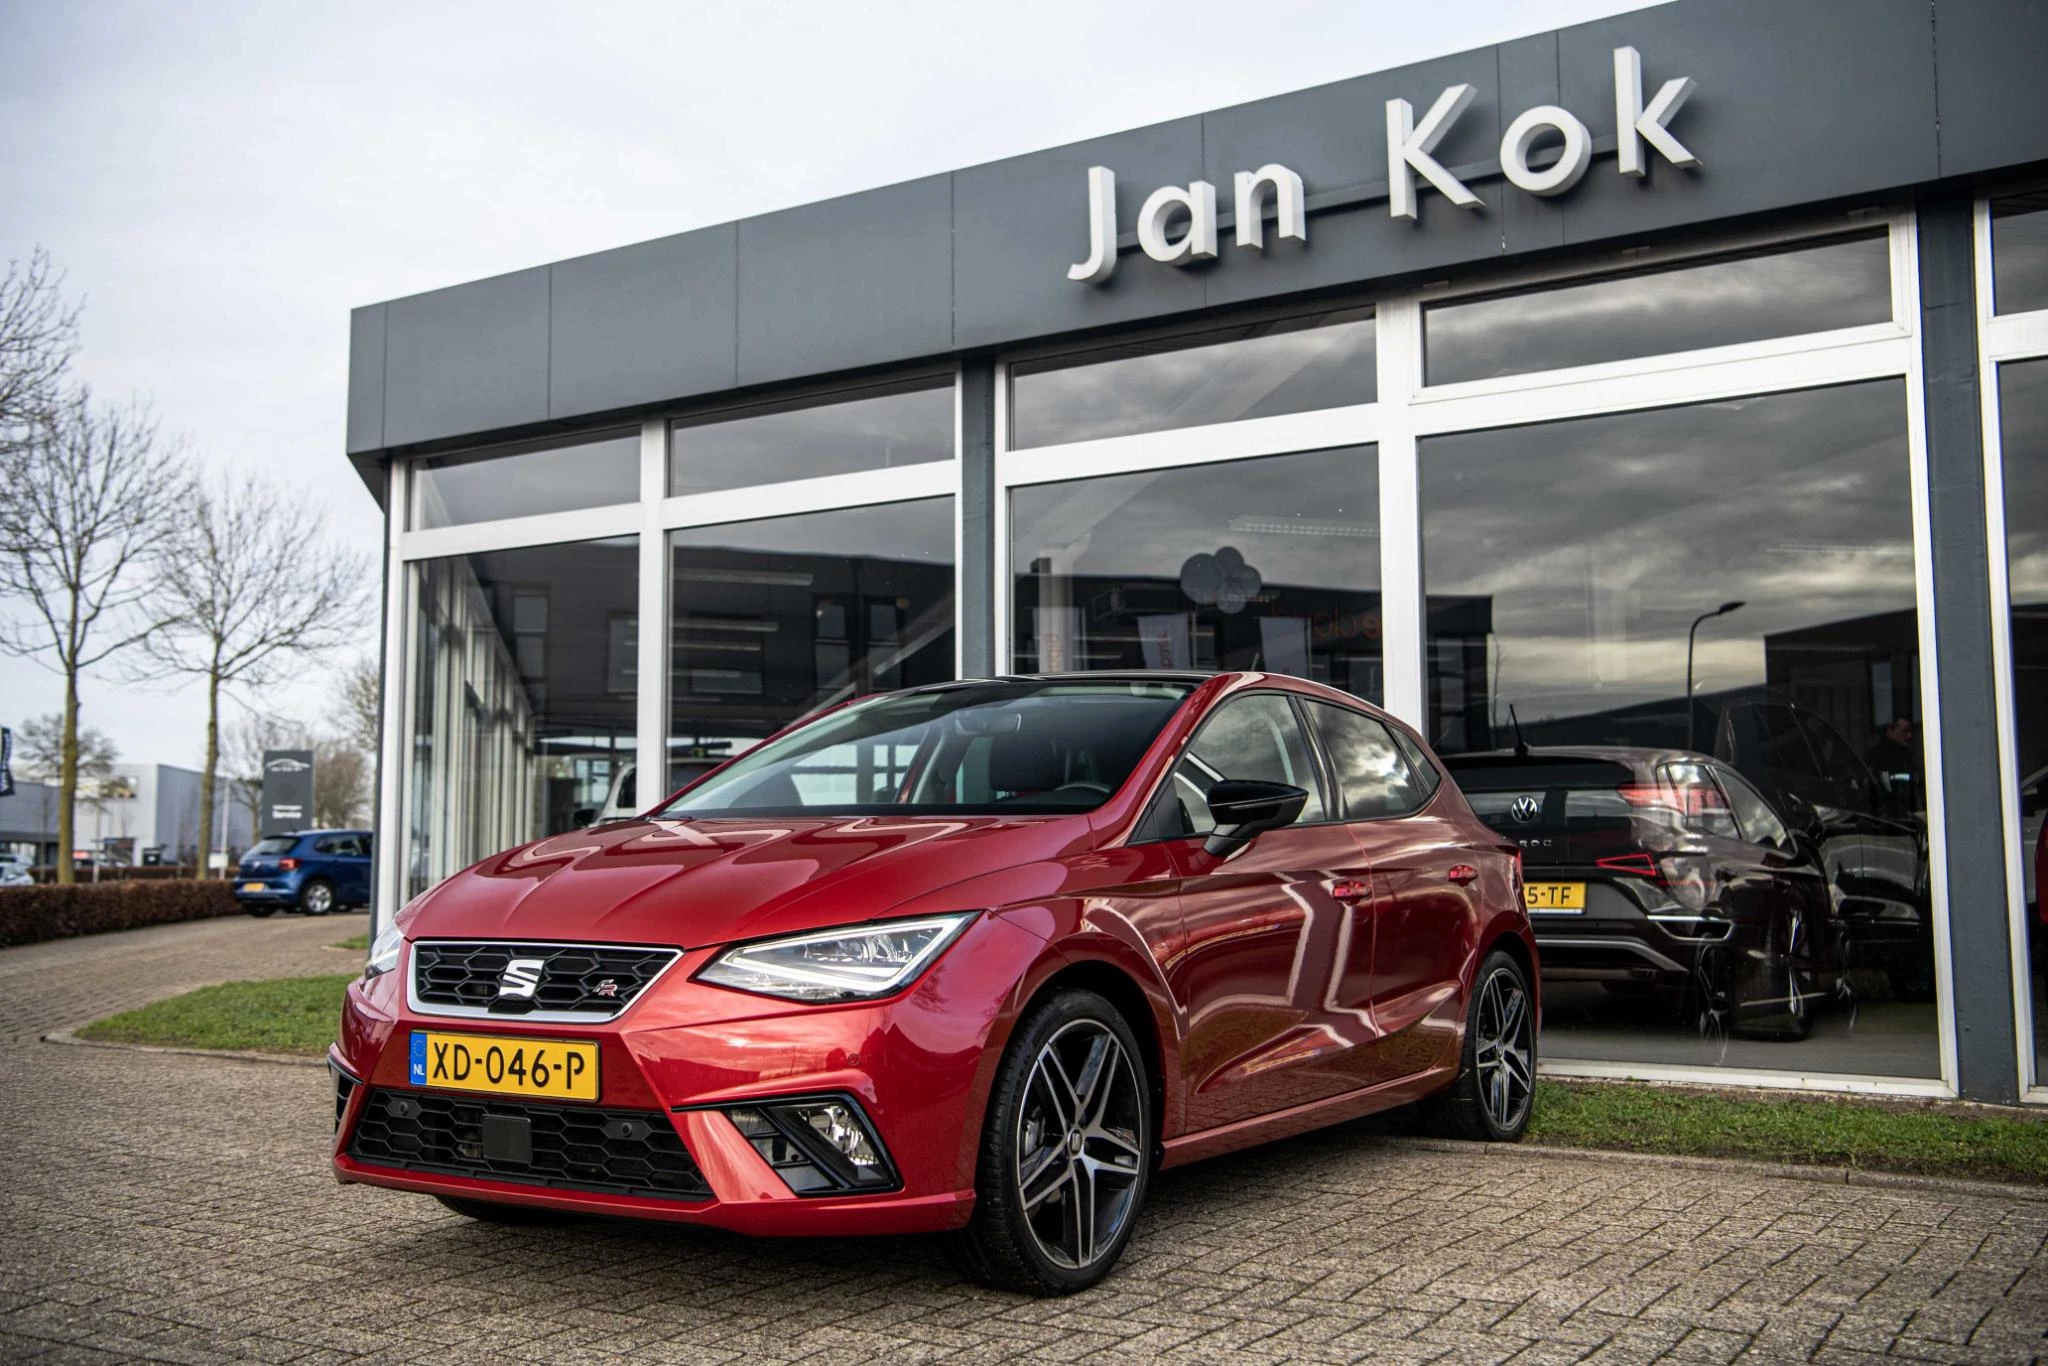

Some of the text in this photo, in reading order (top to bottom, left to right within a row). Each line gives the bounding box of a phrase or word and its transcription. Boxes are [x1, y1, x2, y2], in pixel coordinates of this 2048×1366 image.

[1067, 45, 1703, 283] Jan Kok
[1523, 886, 1571, 905] 5-TF
[413, 1063, 424, 1076] NL
[433, 1042, 585, 1090] XD-046-P
